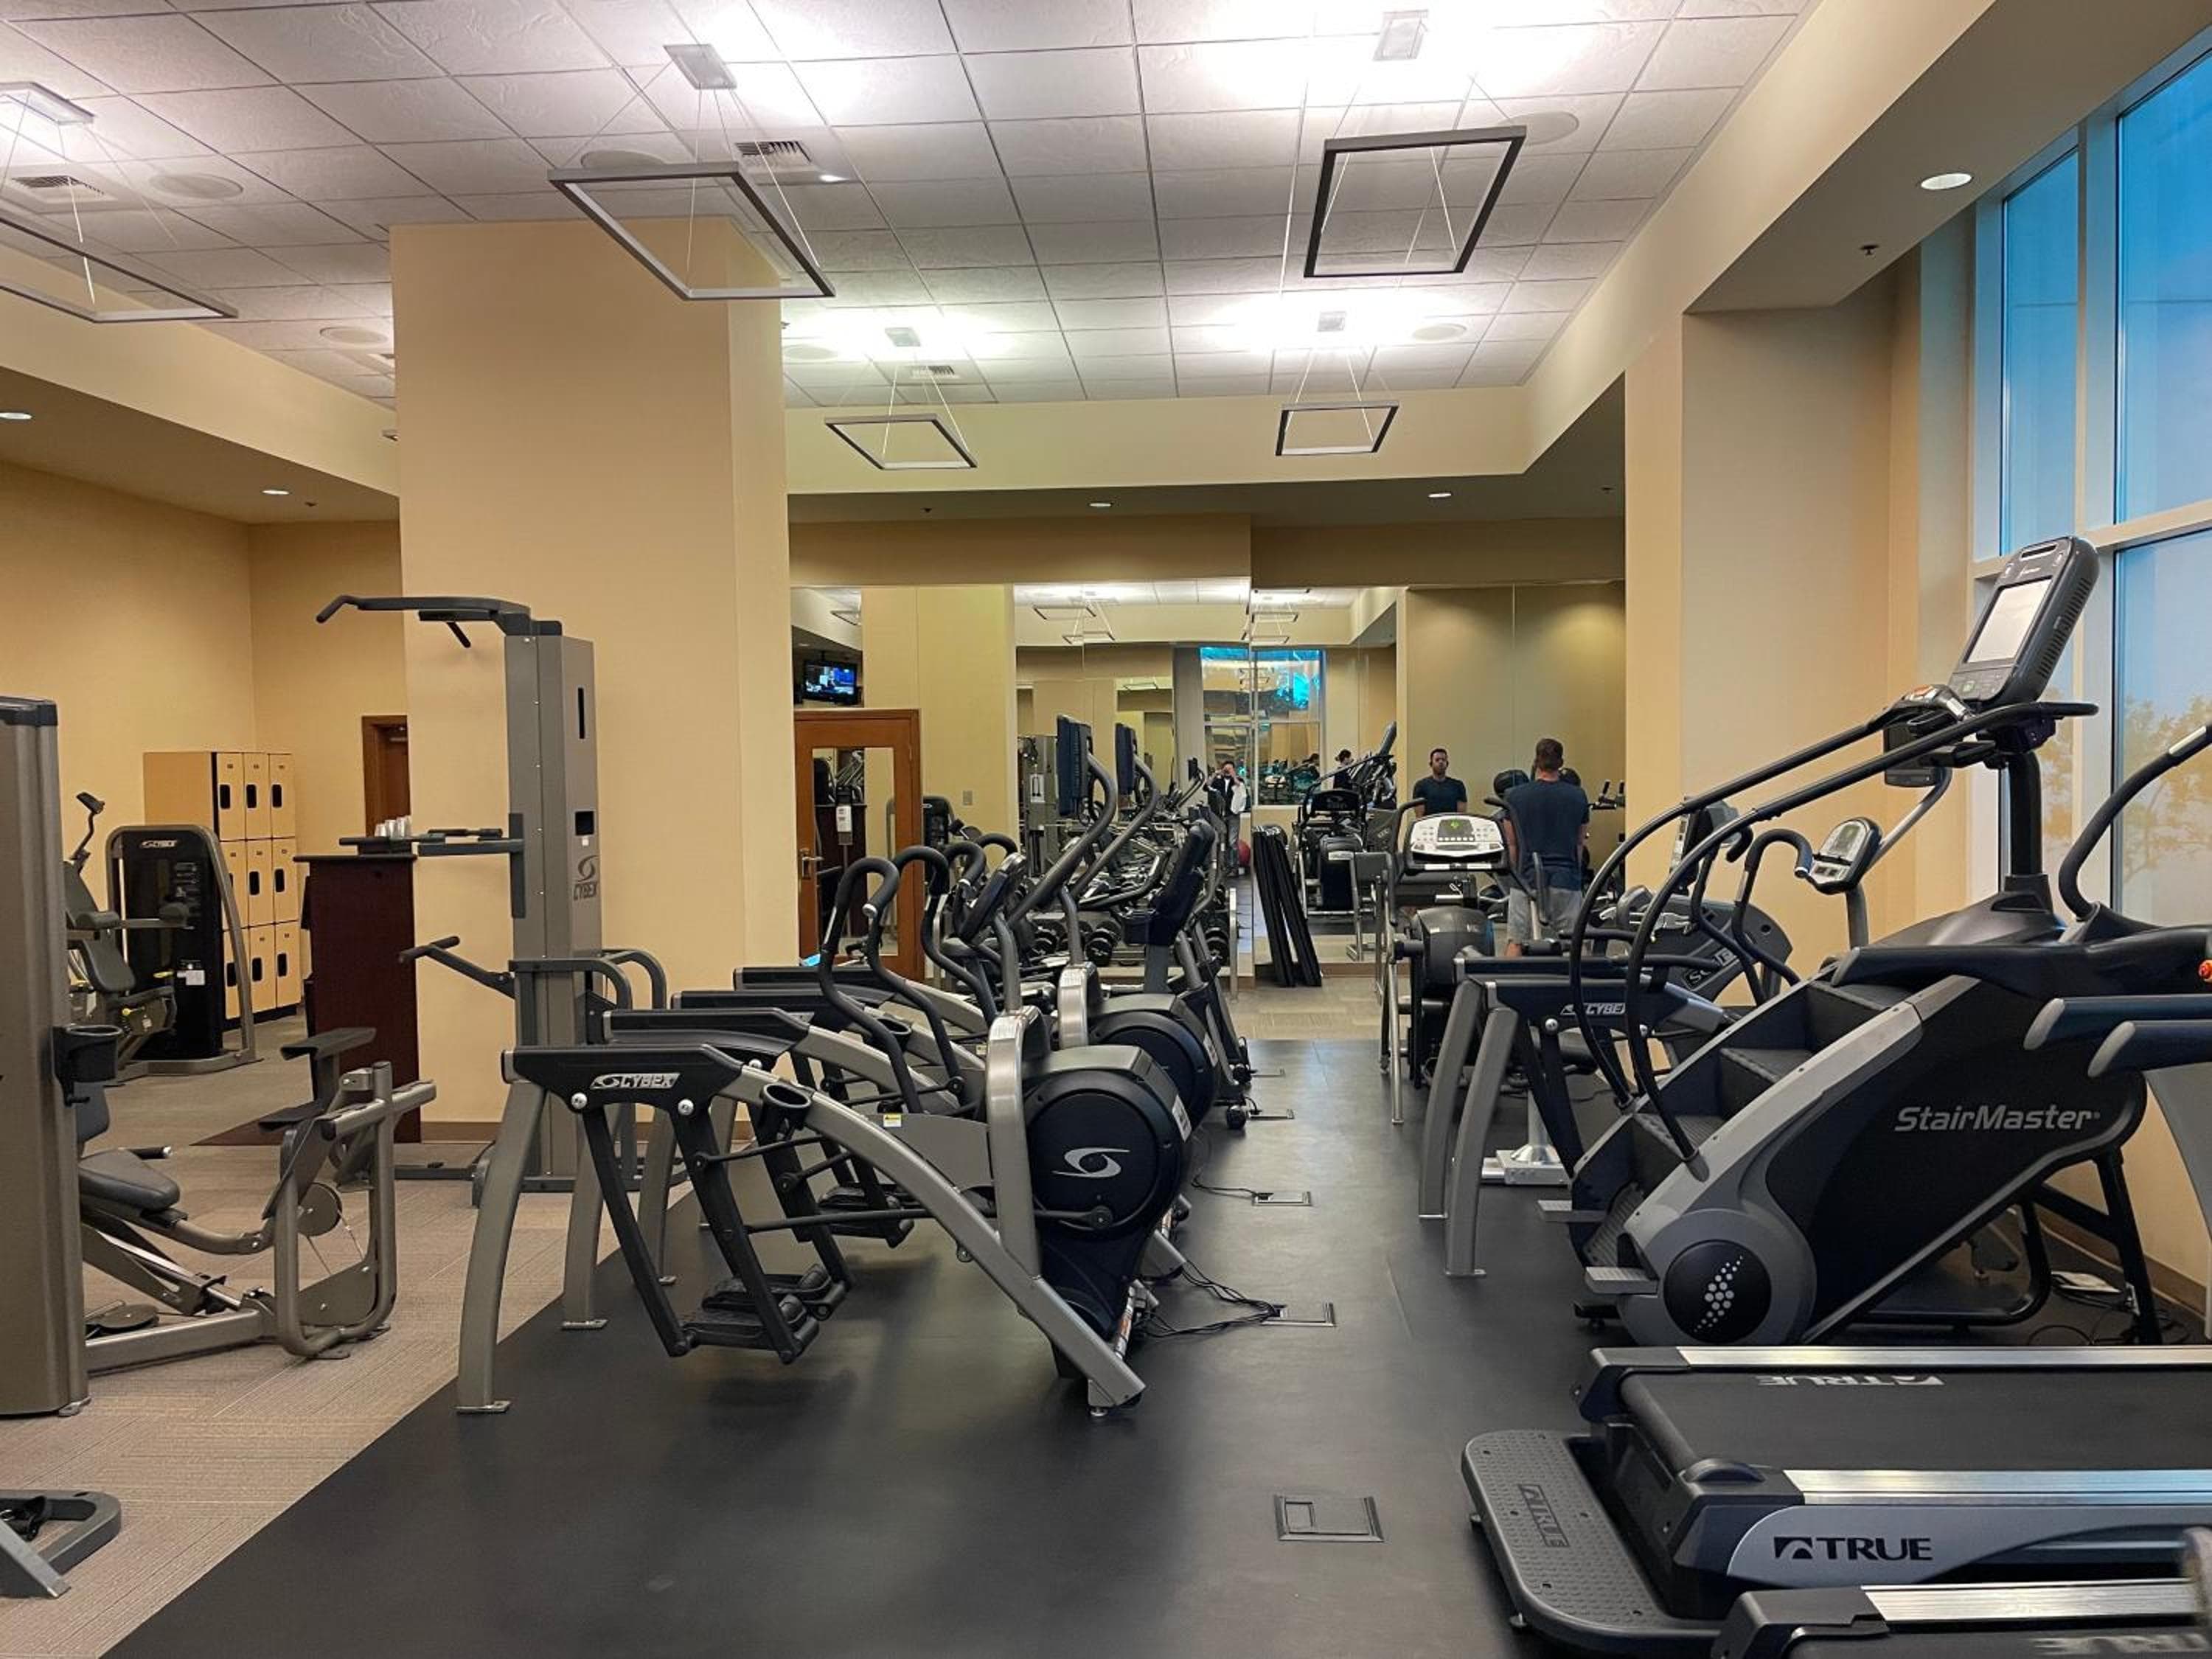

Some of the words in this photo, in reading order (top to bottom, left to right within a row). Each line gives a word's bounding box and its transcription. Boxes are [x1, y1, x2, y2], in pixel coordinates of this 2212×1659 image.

[1583, 1002, 1626, 1015] CYBE
[1894, 1105, 2093, 1132] StairMaster
[1755, 1375, 1896, 1385] TRUE
[1815, 1537, 1934, 1561] TRUE
